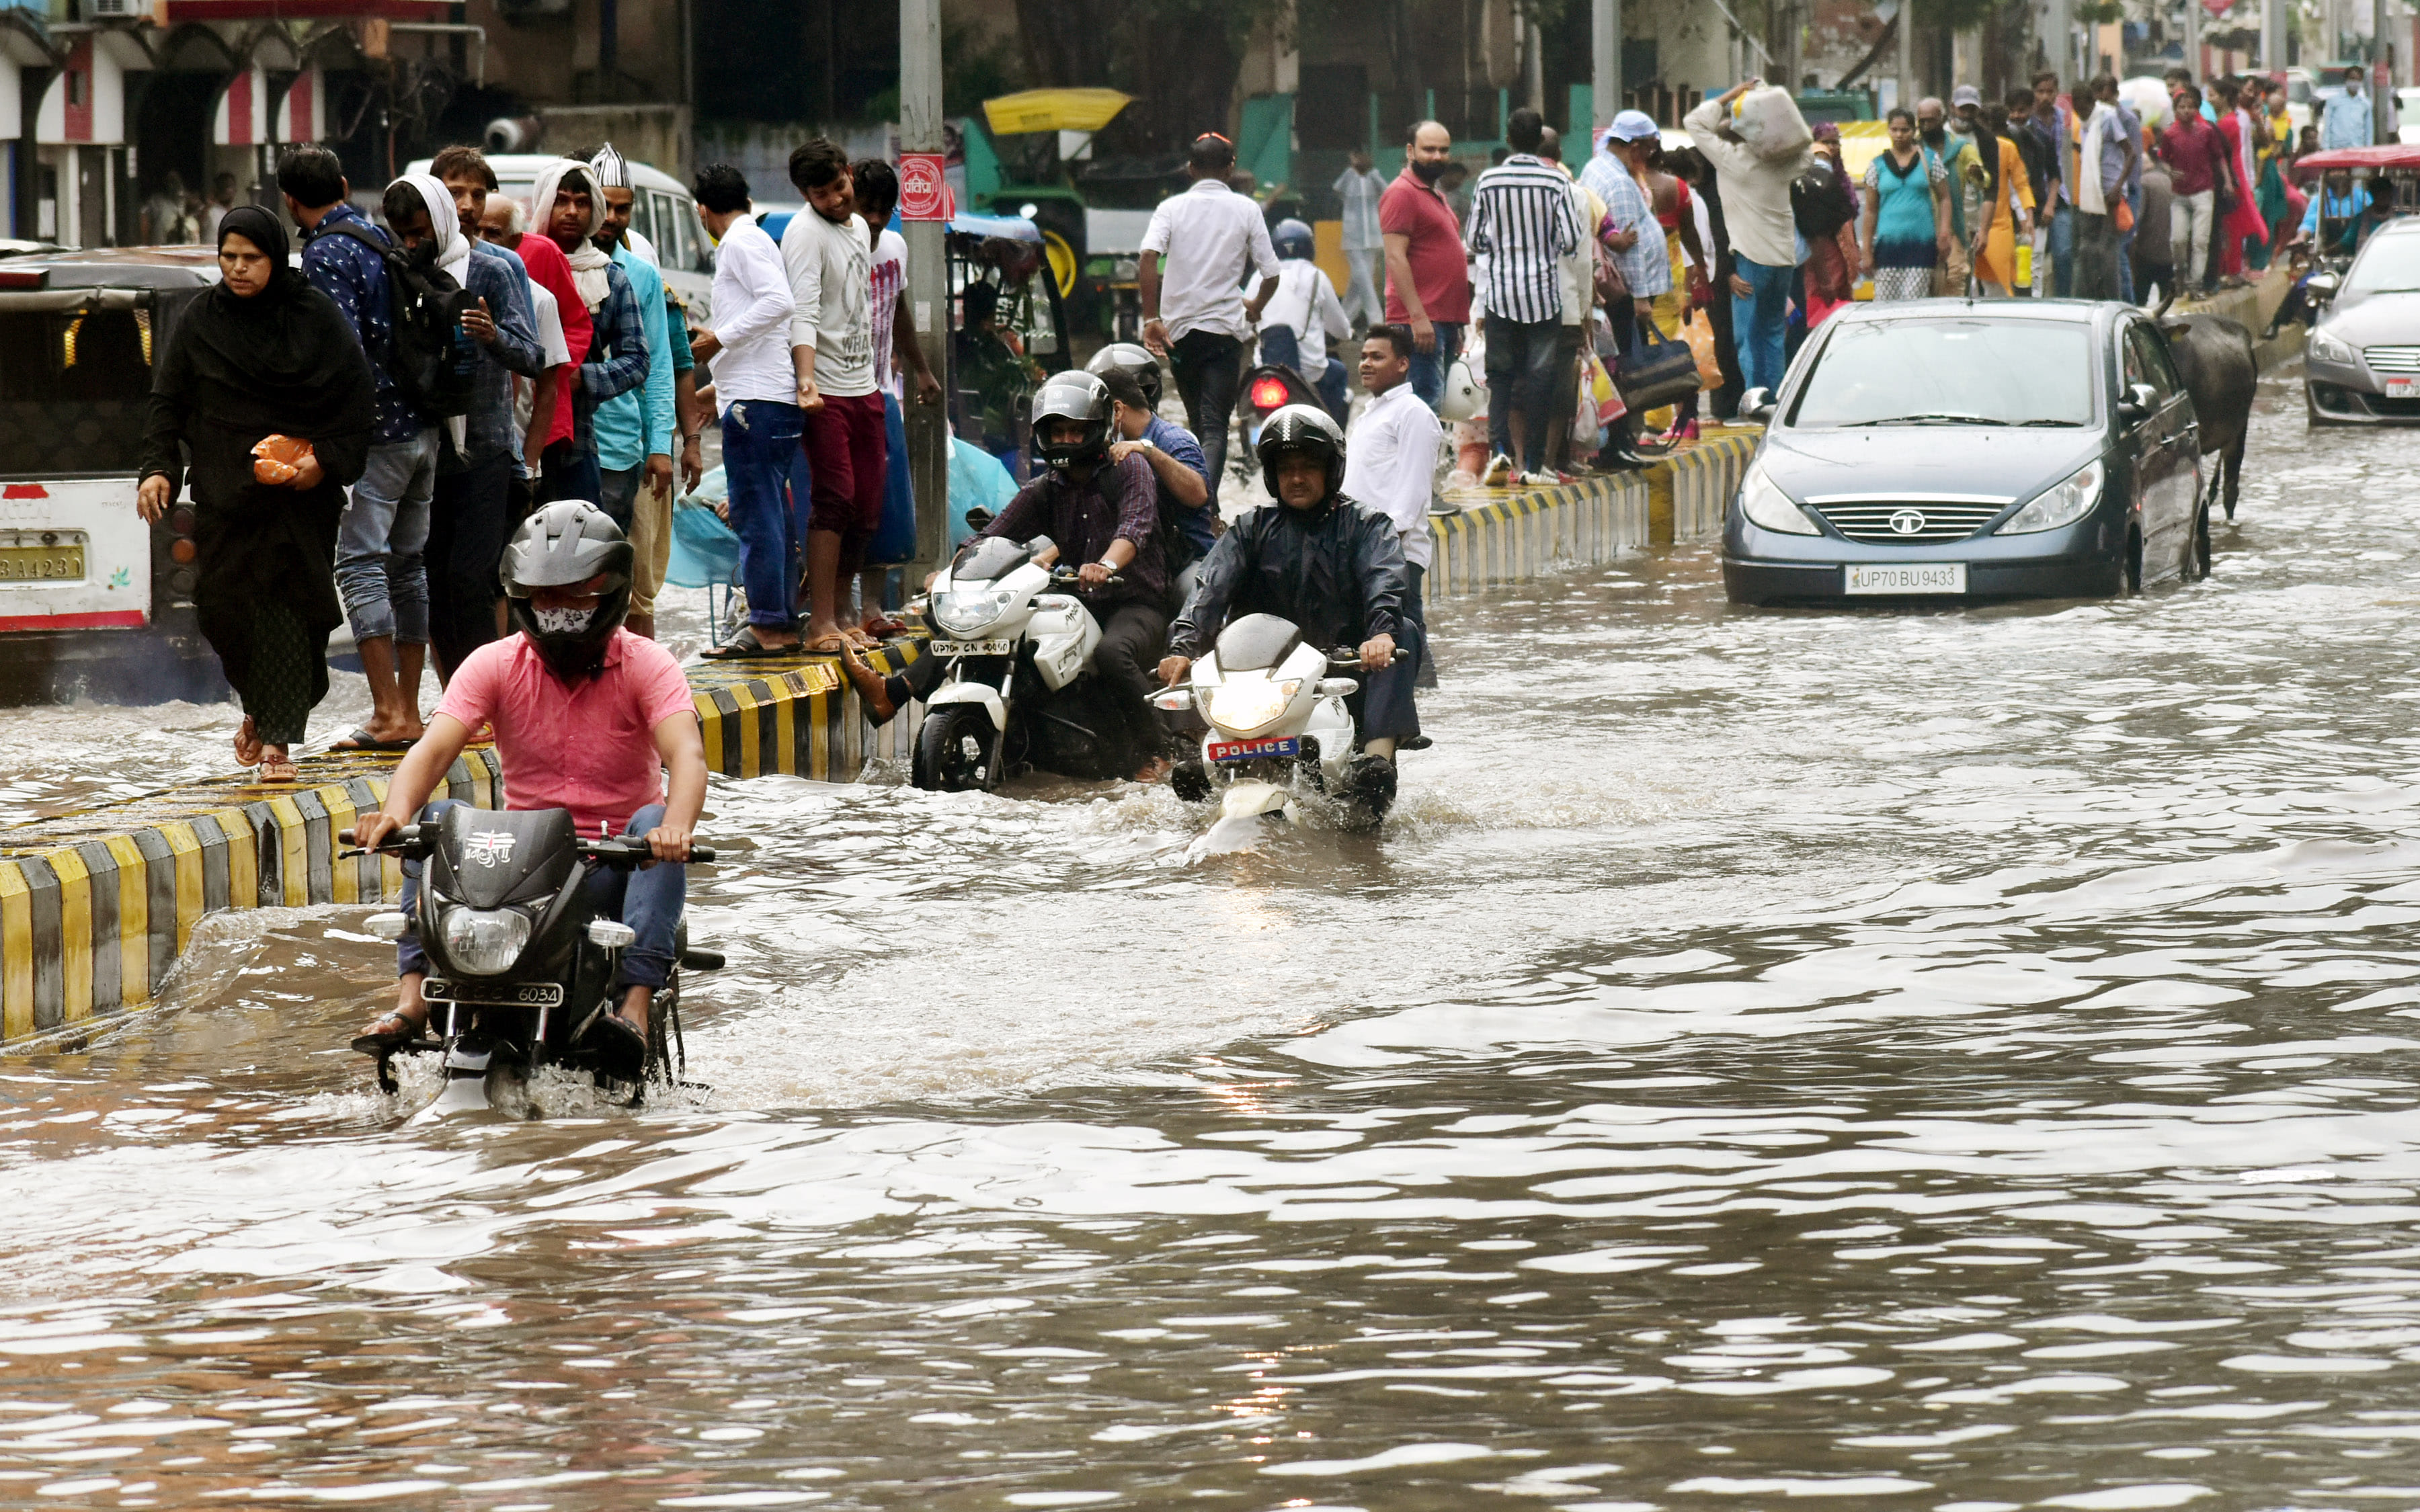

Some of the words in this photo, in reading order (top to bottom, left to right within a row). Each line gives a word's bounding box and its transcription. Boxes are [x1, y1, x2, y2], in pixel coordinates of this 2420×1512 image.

[1861, 571, 1897, 587] UP70
[1900, 571, 1920, 586] BU
[1922, 571, 1955, 586] 9433
[932, 643, 955, 654] UP70
[963, 643, 978, 653] CN
[1216, 741, 1291, 757] POLICE
[518, 988, 558, 1002] 6034
